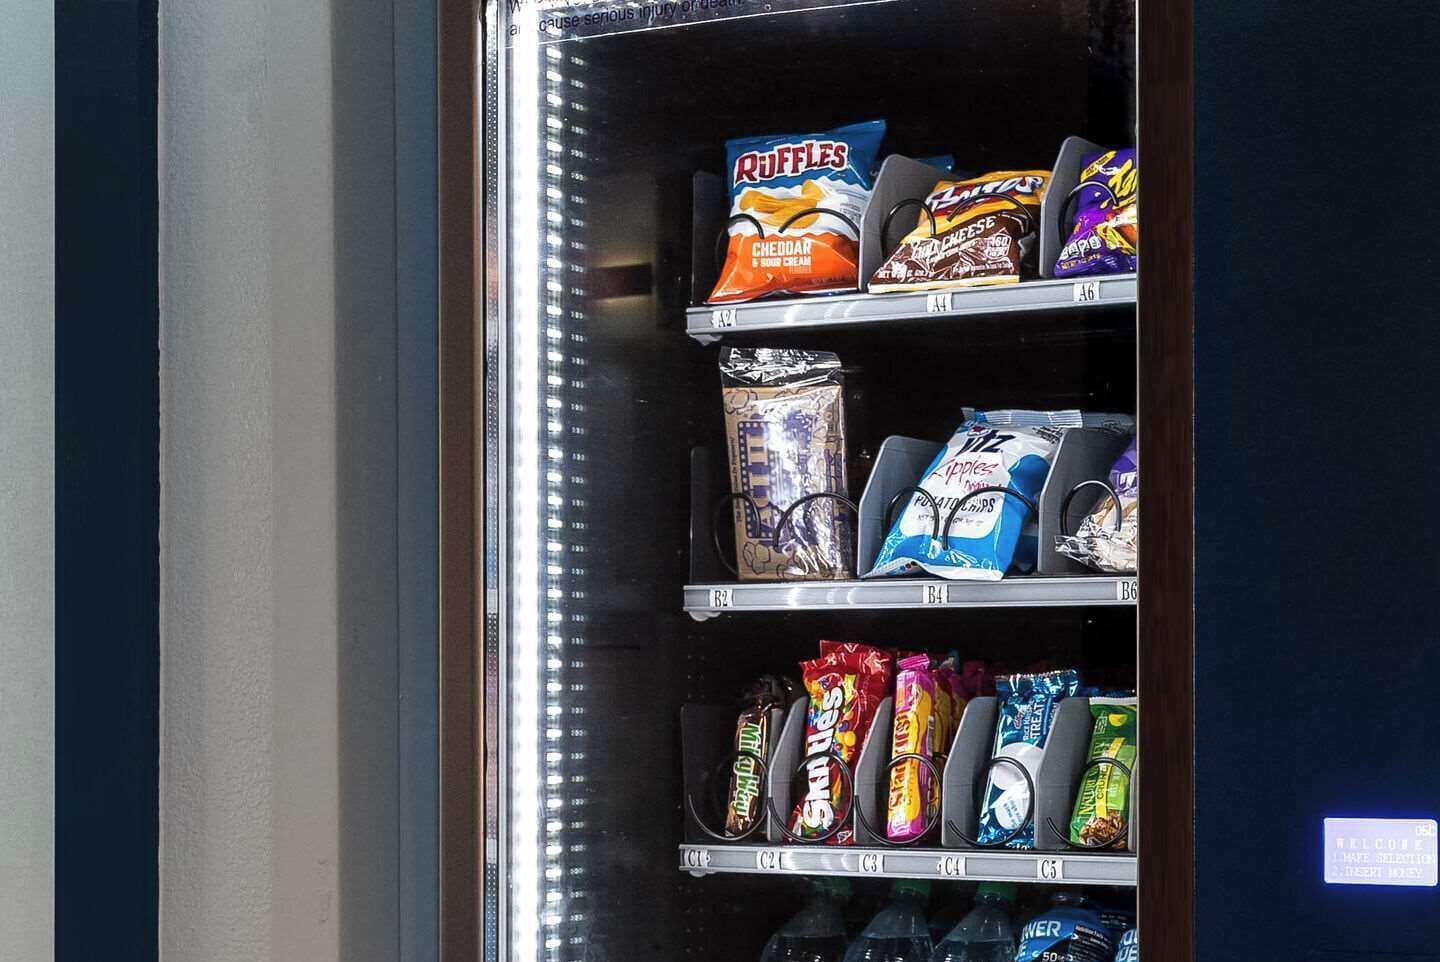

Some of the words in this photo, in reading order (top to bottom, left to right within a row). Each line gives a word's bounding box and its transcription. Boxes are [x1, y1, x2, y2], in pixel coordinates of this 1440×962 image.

[539, 15, 580, 32] cause
[584, 10, 634, 26] serious
[639, 2, 677, 21] injury
[735, 140, 848, 184] RUFFLES
[942, 215, 998, 250] CHEESE
[752, 238, 811, 257] CHEDDAR
[761, 257, 782, 268] SOUR
[783, 255, 812, 267] CREAM
[1079, 283, 1095, 302] A6
[932, 295, 947, 313] A4
[713, 590, 729, 608] B2
[928, 585, 943, 604] B4
[1121, 581, 1137, 601] B6
[760, 851, 775, 869] C2
[863, 854, 878, 872] C3
[945, 857, 960, 876] C4
[1041, 860, 1057, 880] C5
